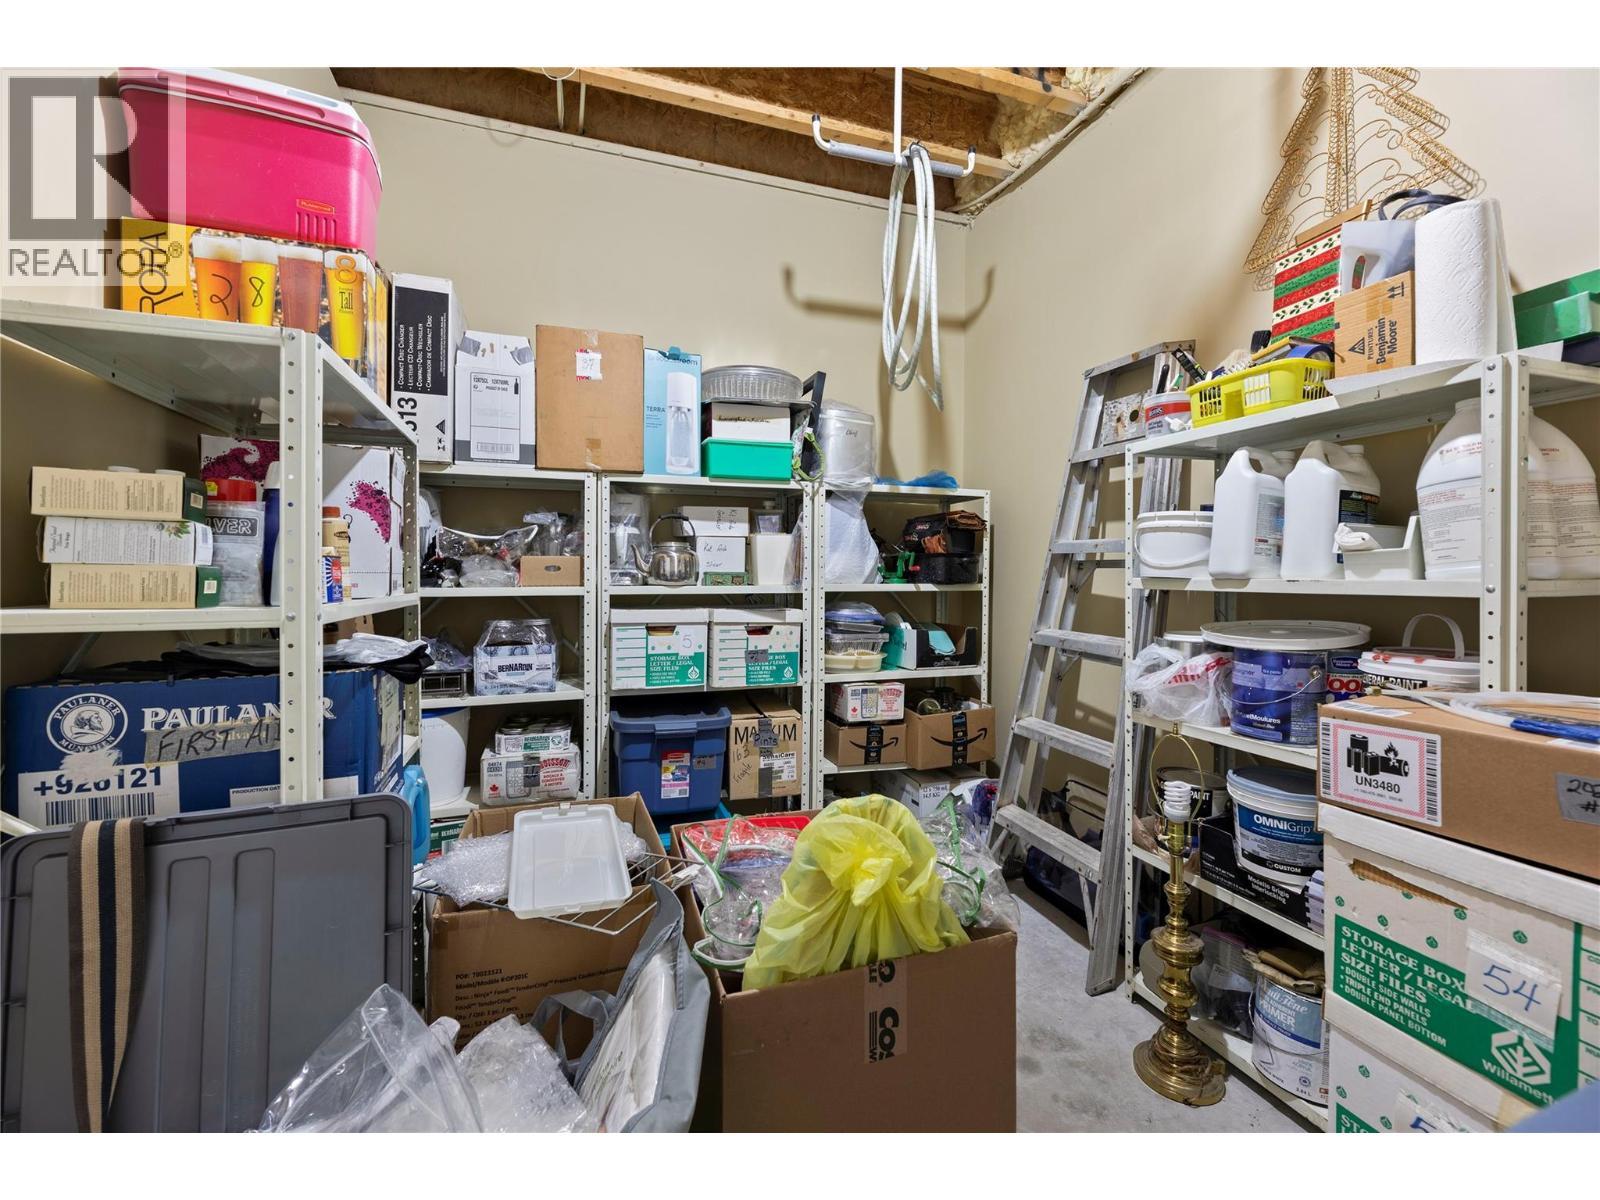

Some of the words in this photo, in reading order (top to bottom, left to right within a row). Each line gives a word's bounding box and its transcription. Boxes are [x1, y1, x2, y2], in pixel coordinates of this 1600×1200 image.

[339, 291, 354, 310] Tall
[1375, 316, 1388, 365] Benjamin
[1387, 320, 1398, 355] Moore
[407, 354, 414, 363] CD
[646, 405, 666, 413] TERRA
[498, 663, 534, 672] BERNARDIN
[1388, 677, 1424, 691] PAINT
[54, 696, 121, 720] PAULANER
[141, 697, 336, 732] PAULANR
[157, 728, 235, 761] FIRST
[231, 786, 268, 794] PRODUCTION
[1355, 775, 1400, 794] UN3480
[1254, 814, 1312, 835] OMNIGrip
[1274, 863, 1301, 873] CUSTOM
[1341, 925, 1419, 971] STORAGE
[1424, 968, 1466, 996] BOX
[1341, 938, 1401, 980] LETTER
[1417, 975, 1476, 1014] LEGAL
[1340, 953, 1376, 978] SIZE
[1380, 971, 1428, 1004] FILES
[1345, 966, 1376, 988] DOUBLE
[1378, 980, 1397, 997] SIDE
[1400, 990, 1432, 1018] WALLS
[1484, 965, 1542, 1012] 54
[1260, 1000, 1295, 1029] PRIMER
[1345, 975, 1372, 996] TRIPLE
[1374, 988, 1391, 1006] END
[1393, 998, 1428, 1027] PANELS
[1345, 985, 1376, 1009] DOUBLE
[1379, 1001, 1406, 1025] PANEL
[1408, 1016, 1447, 1046] BOTTOM
[1482, 1058, 1555, 1106] Willamett
